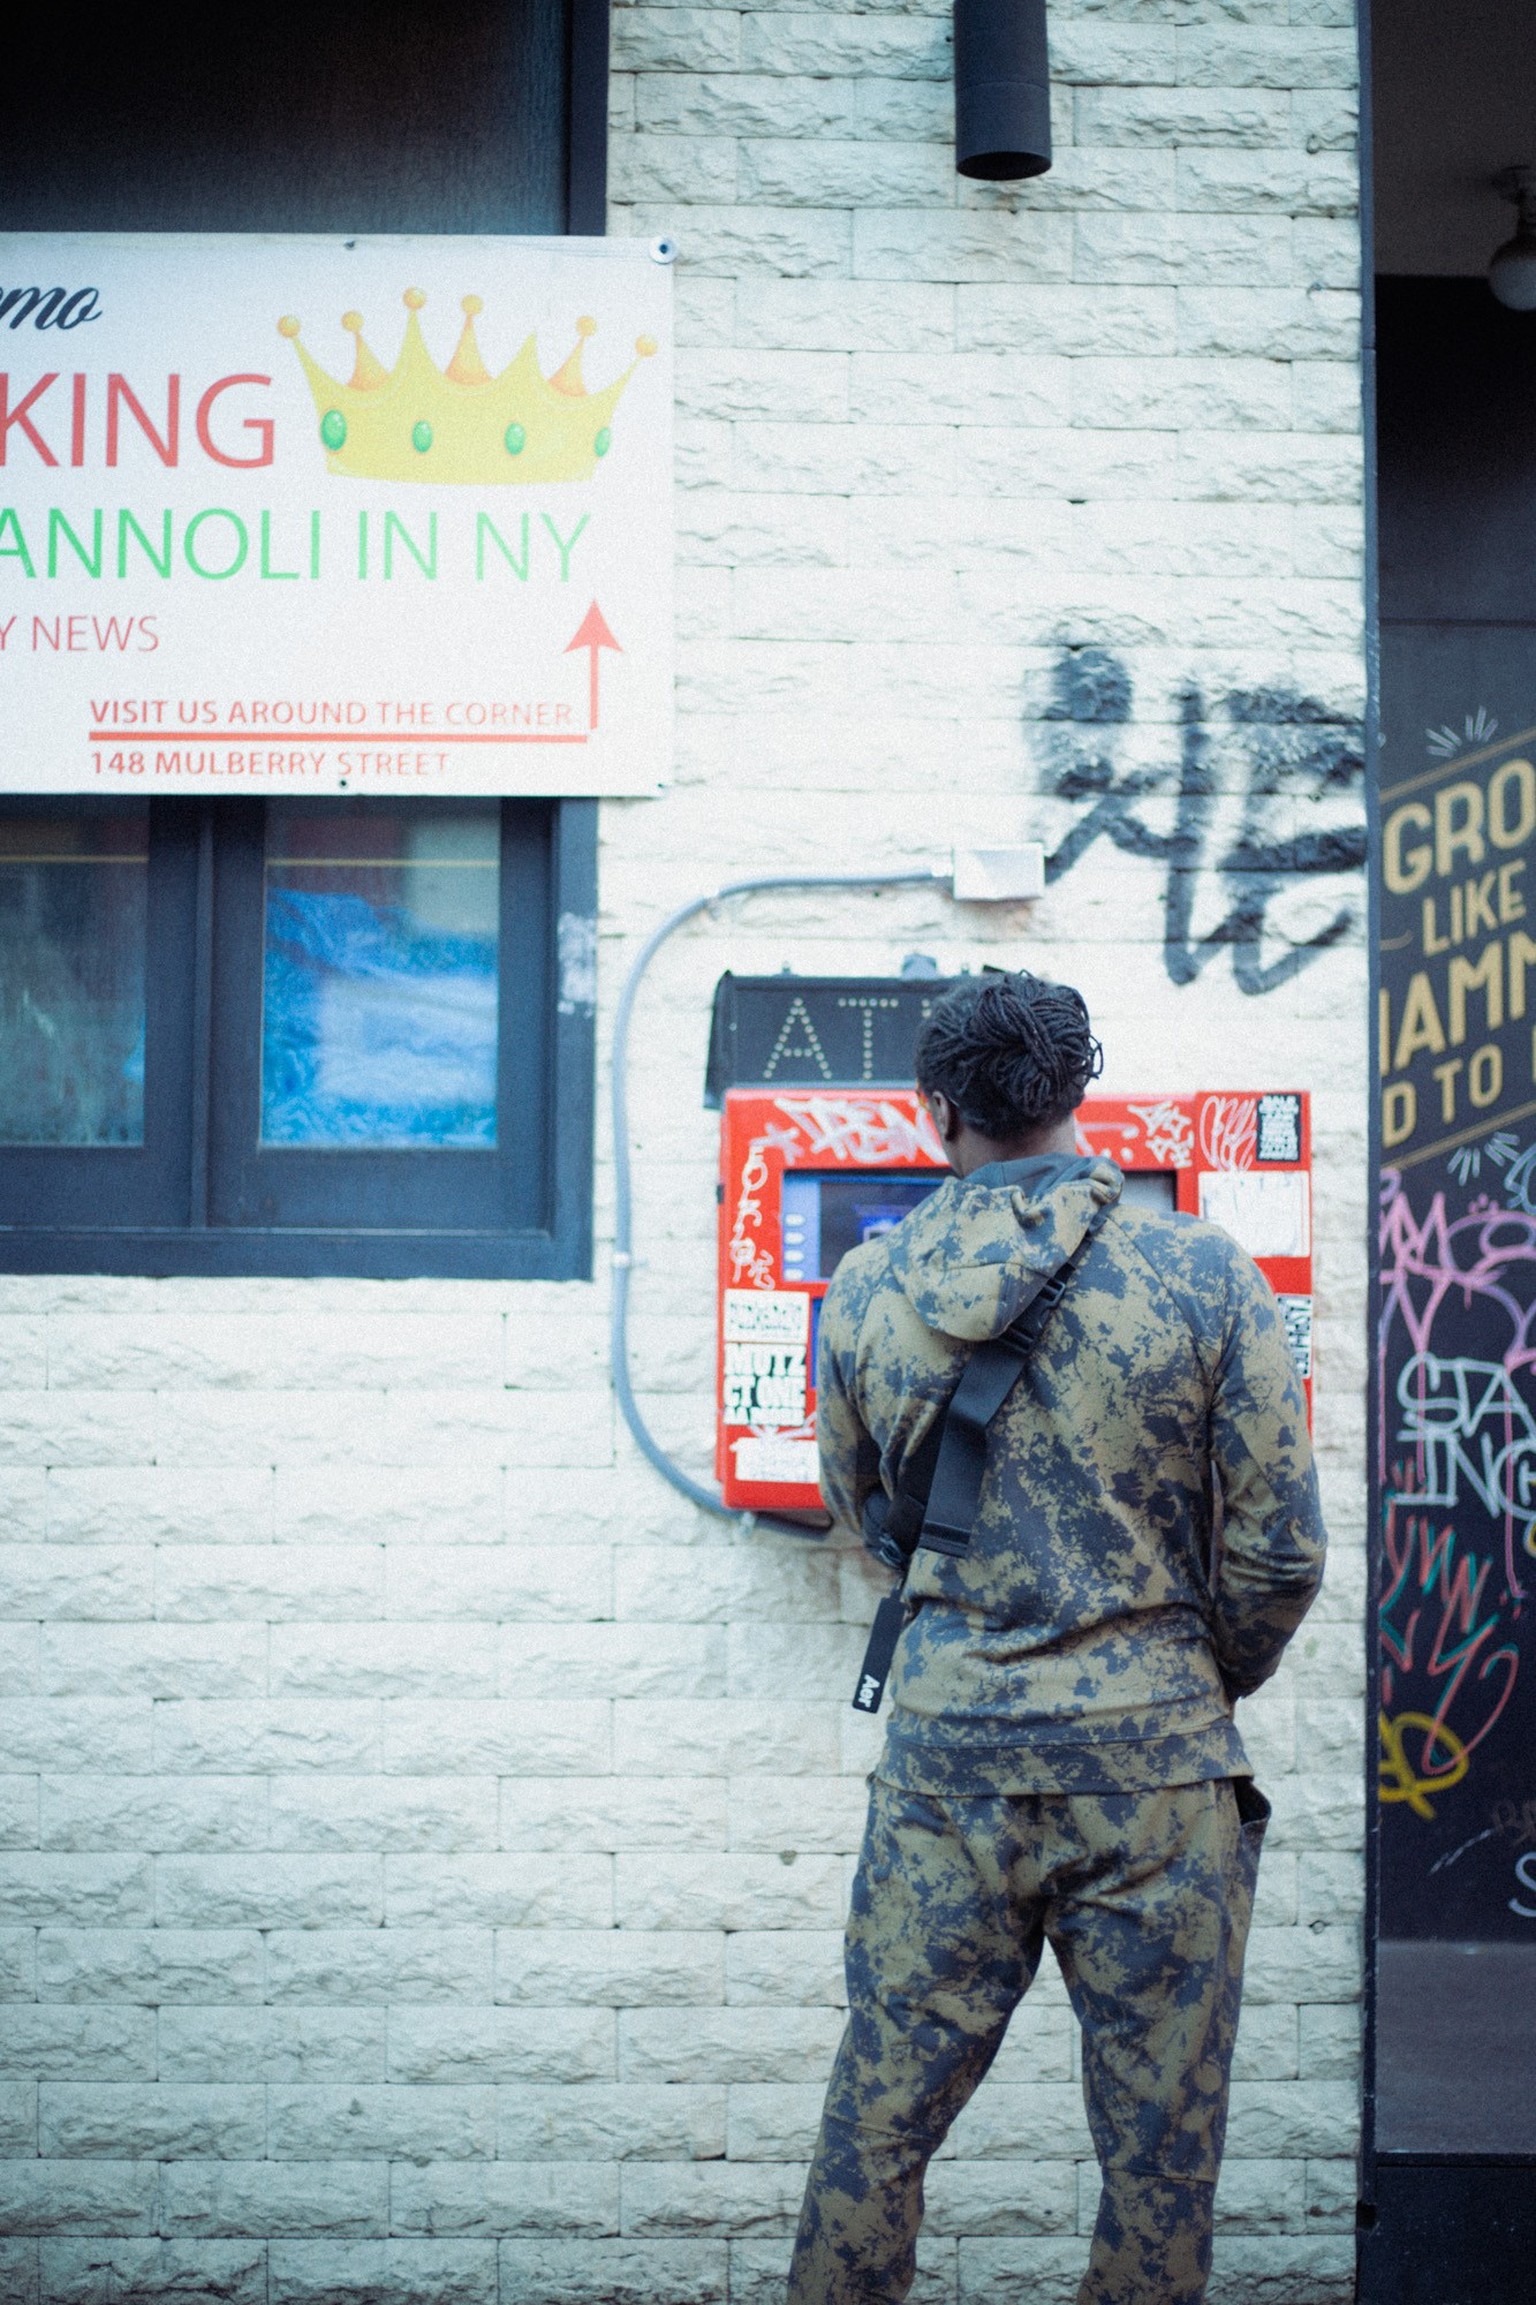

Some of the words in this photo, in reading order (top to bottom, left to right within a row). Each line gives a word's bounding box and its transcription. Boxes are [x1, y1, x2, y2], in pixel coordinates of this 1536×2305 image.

[0, 372, 275, 469] KING
[0, 507, 321, 580] ANNOLI
[358, 509, 438, 581] IN
[476, 510, 592, 583] NY
[32, 615, 160, 652] NEWS
[90, 699, 168, 724] VISIT
[178, 700, 219, 724] US
[228, 700, 367, 725] AROUND
[377, 701, 434, 725] THE
[446, 702, 572, 726] CORNER
[91, 750, 146, 775] 148
[155, 750, 327, 775] MULBERRY
[337, 751, 449, 776] STREET
[1422, 857, 1527, 957] LIKE
[763, 998, 931, 1080] AT
[1433, 1042, 1503, 1125] TO
